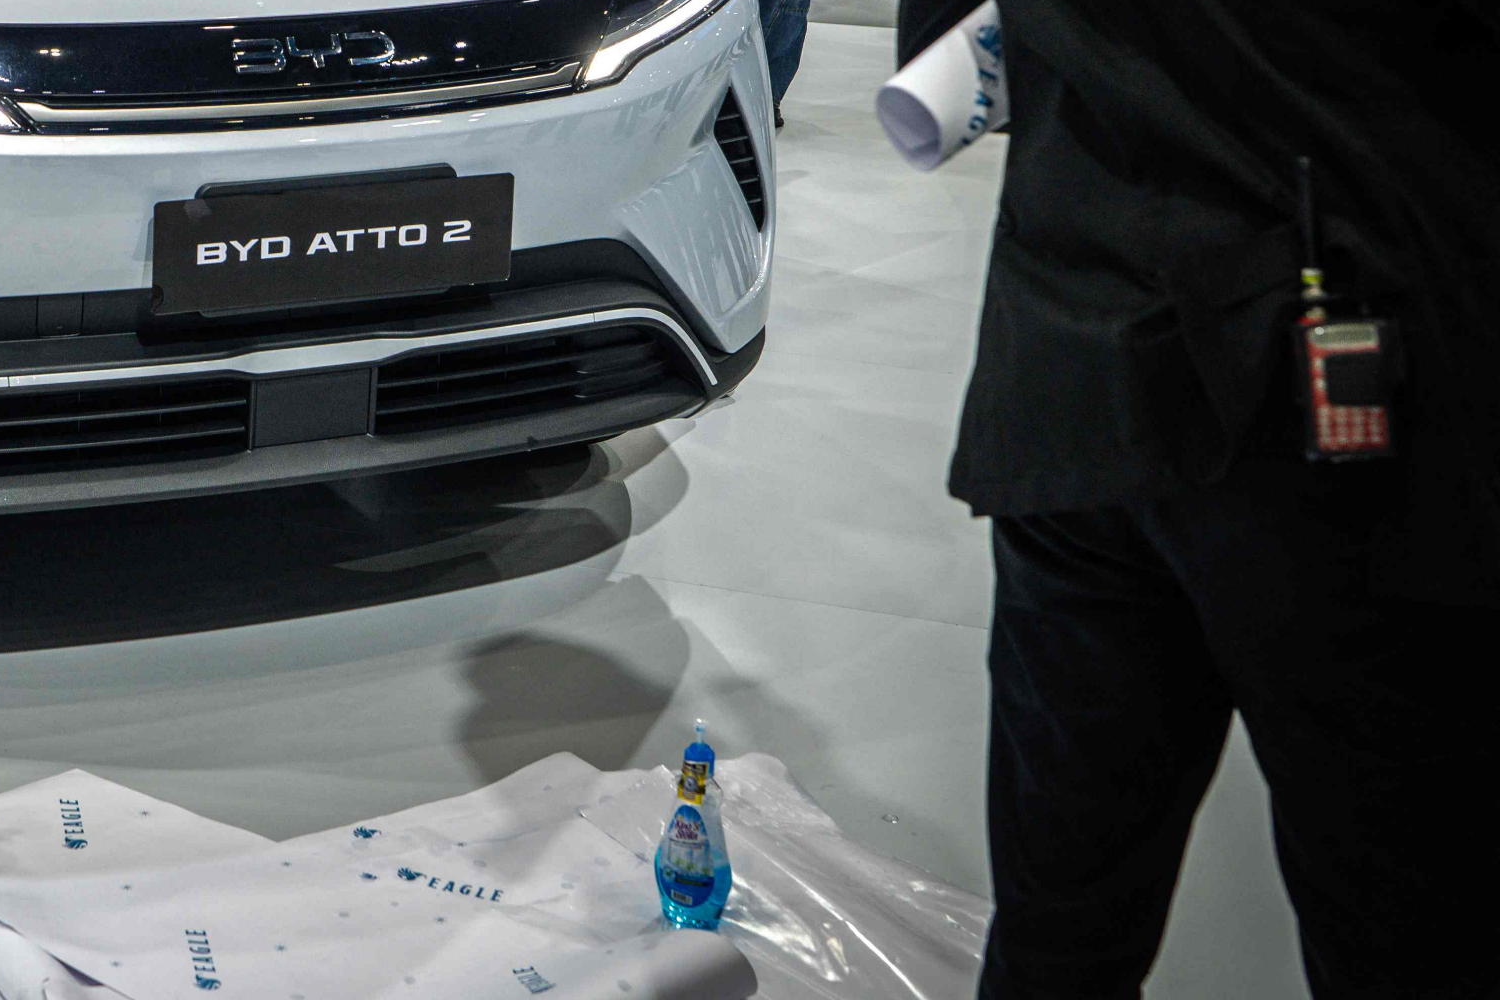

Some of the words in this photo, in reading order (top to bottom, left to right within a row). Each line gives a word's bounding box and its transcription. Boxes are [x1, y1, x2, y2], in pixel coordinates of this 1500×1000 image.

[232, 30, 395, 74] BYD
[196, 235, 291, 265] BYD
[306, 224, 427, 256] ATTO
[443, 220, 472, 243] 2
[59, 798, 84, 835] EAGLE
[427, 877, 505, 902] EAGLE
[185, 929, 216, 973] EAGLE
